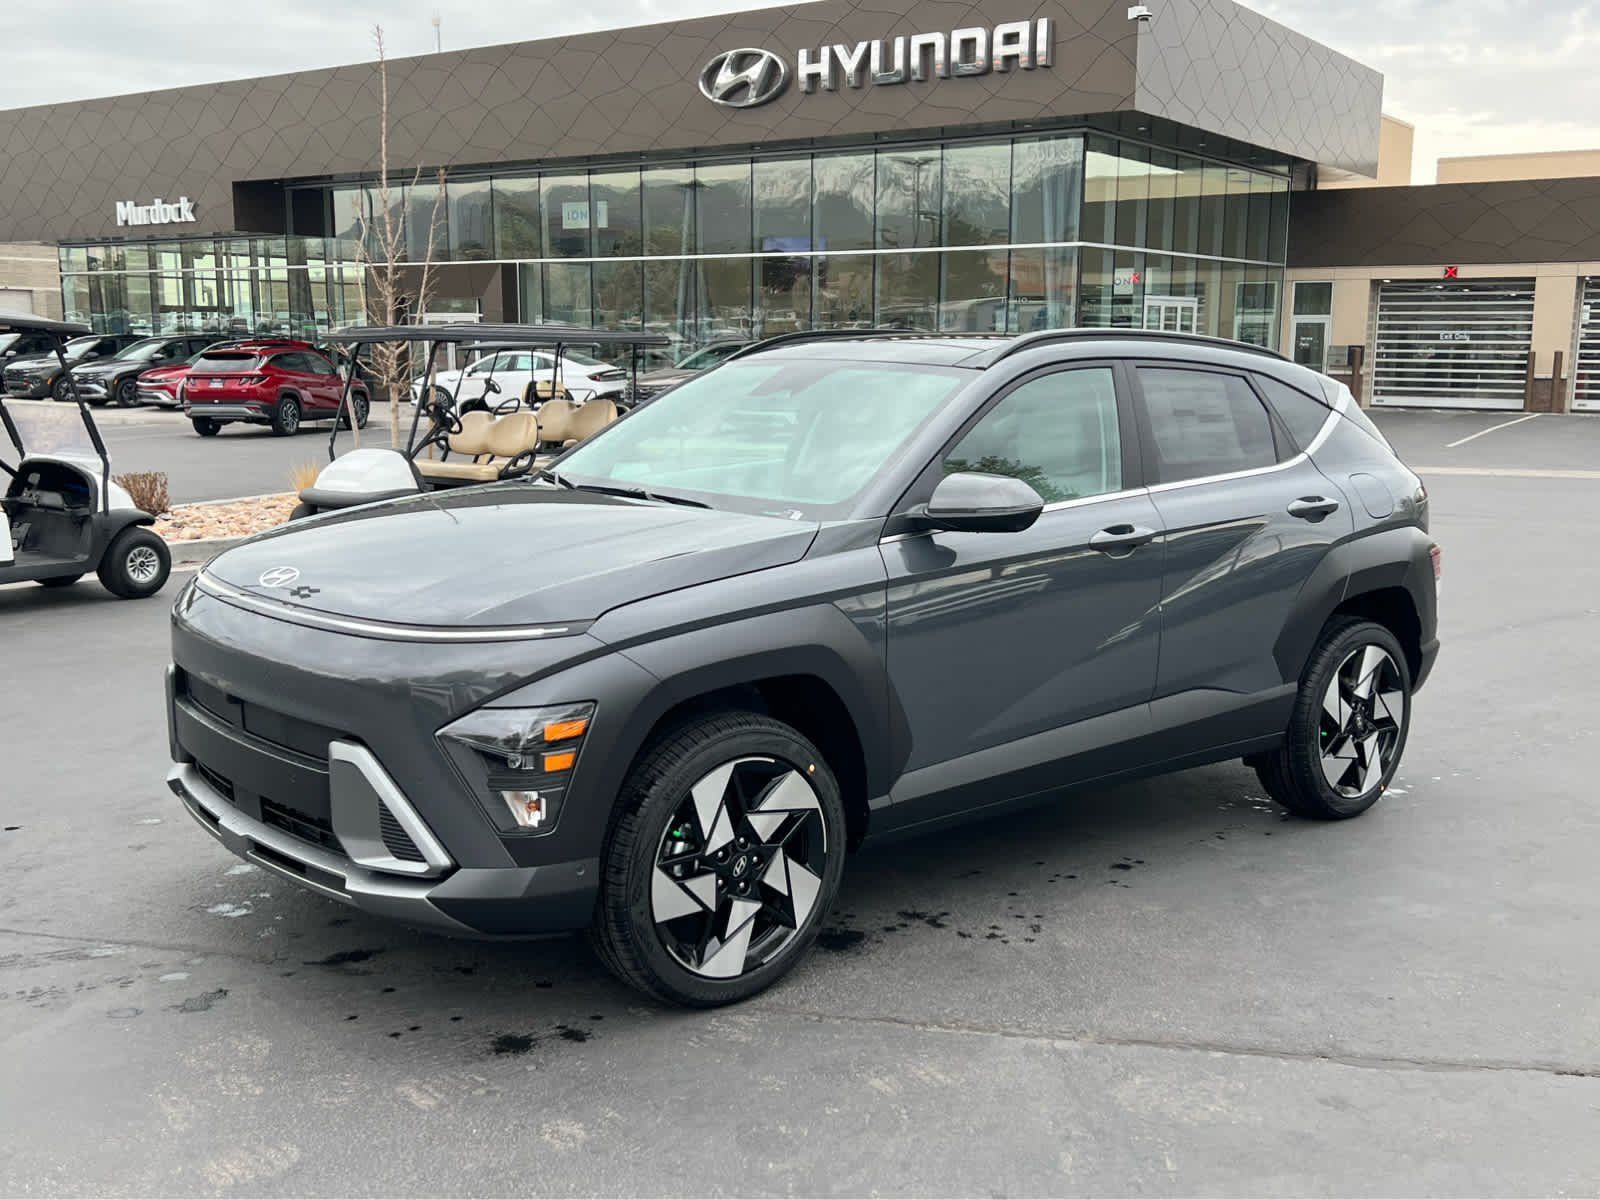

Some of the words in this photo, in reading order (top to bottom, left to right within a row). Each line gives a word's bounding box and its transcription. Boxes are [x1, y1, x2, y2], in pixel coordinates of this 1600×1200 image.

[798, 17, 1053, 94] HYUNDAI
[116, 196, 196, 226] Murdock
[1439, 331, 1454, 340] Exit
